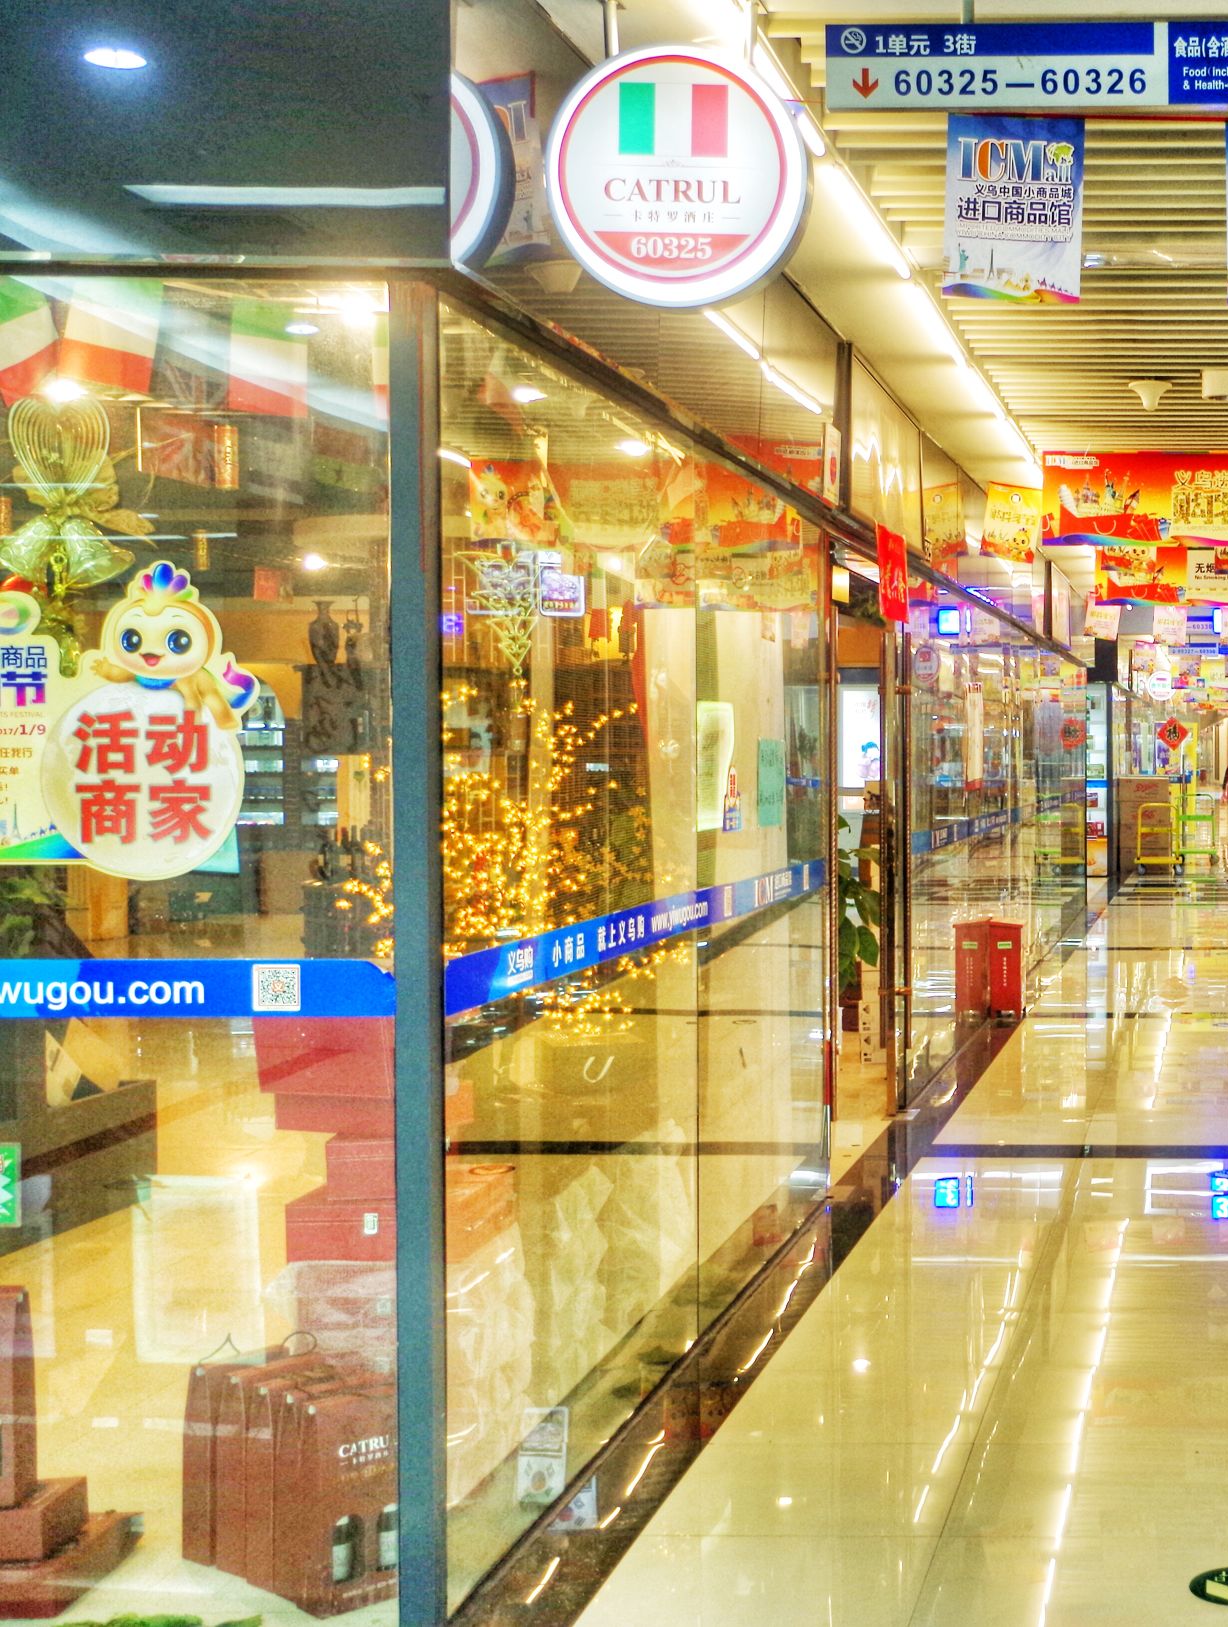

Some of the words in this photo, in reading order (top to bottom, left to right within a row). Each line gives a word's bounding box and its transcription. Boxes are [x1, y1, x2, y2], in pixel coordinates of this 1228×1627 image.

[875, 35, 930, 55] 1单元
[943, 34, 976, 55] 3街
[1183, 80, 1190, 90] &
[604, 177, 742, 204] CATRUL
[974, 183, 1073, 200] 义乌中国小商品城
[632, 209, 715, 223] 卡特罗酒庄
[957, 197, 1072, 226] 进口商品馆
[631, 235, 712, 260] 60325
[0, 645, 47, 669] 商品
[0, 671, 48, 707] 节
[72, 710, 211, 775] 活动
[75, 779, 213, 845] 商家
[552, 933, 585, 968] 小商品
[338, 1434, 391, 1459] CATRU
